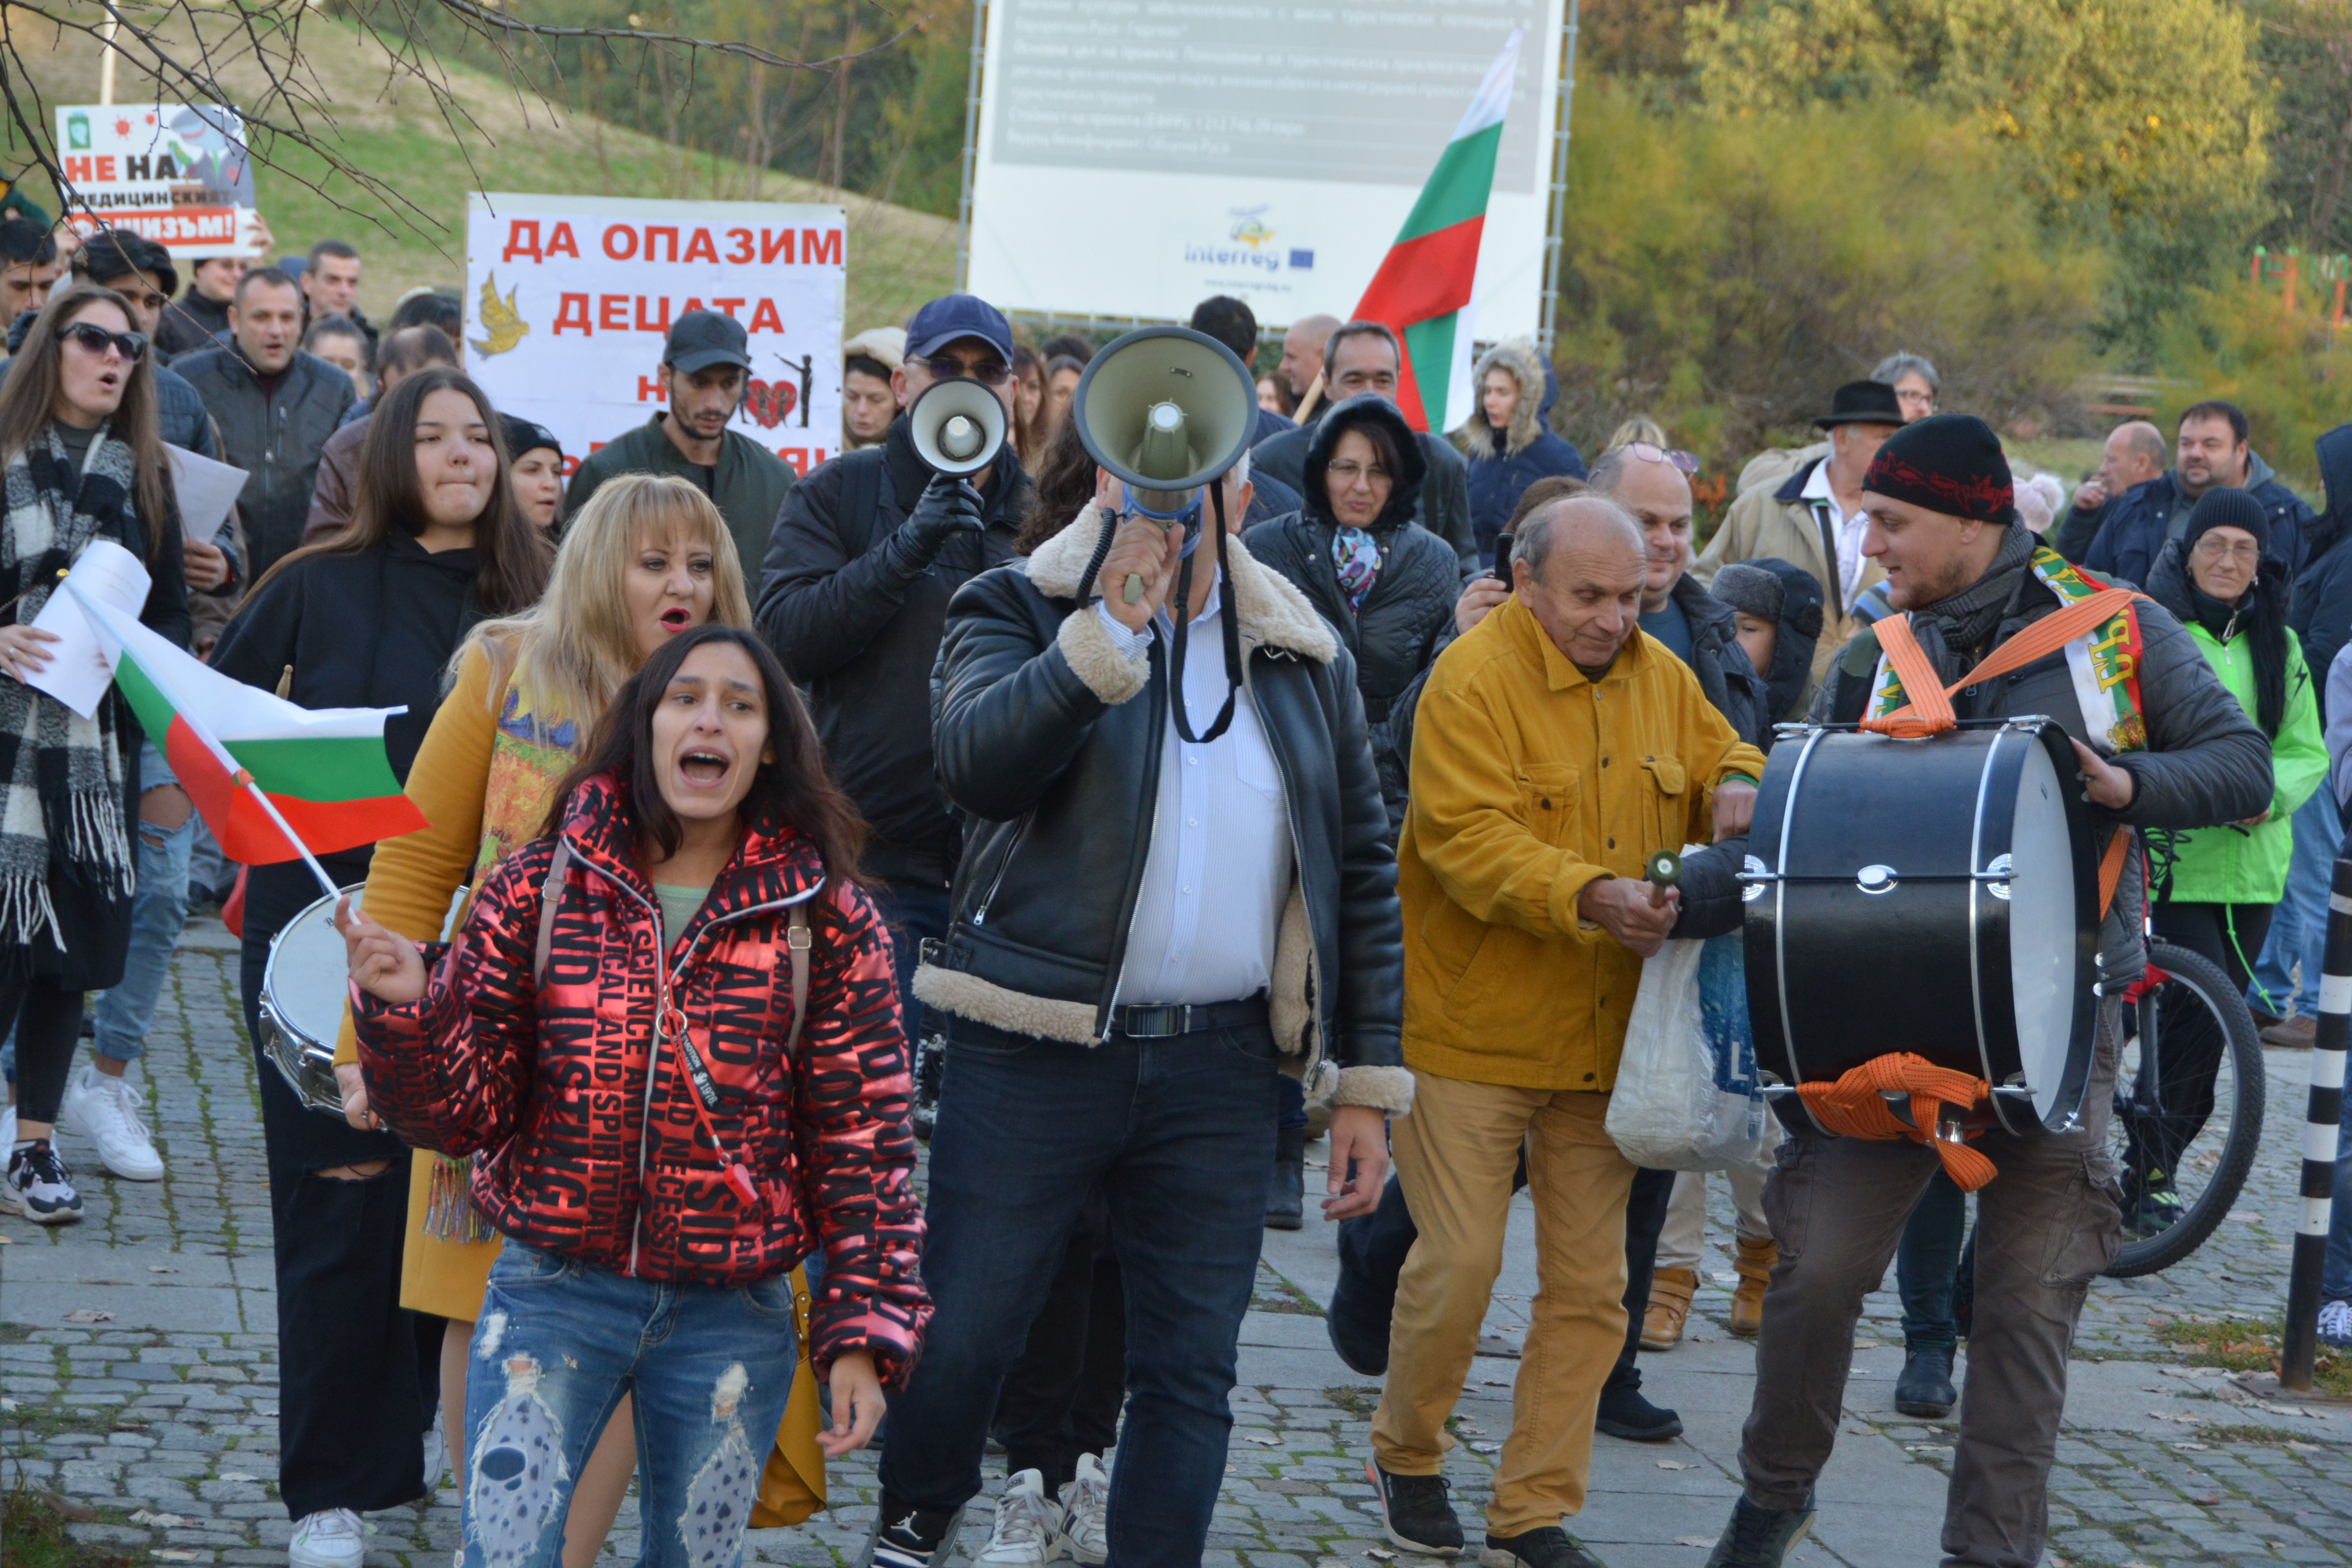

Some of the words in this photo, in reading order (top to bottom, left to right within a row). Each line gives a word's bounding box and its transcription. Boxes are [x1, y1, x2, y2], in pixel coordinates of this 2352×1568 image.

[65, 155, 116, 182] НЕ
[127, 154, 179, 180] НА
[502, 219, 581, 264] ДА
[602, 223, 842, 266] ОПАЗИМ
[548, 885, 610, 985] AND
[624, 930, 655, 1056] SCIENCE
[709, 961, 769, 1066] AND
[848, 978, 905, 1079] AND
[594, 1018, 623, 1082] AND
[584, 1092, 621, 1243] SPIRITUAL
